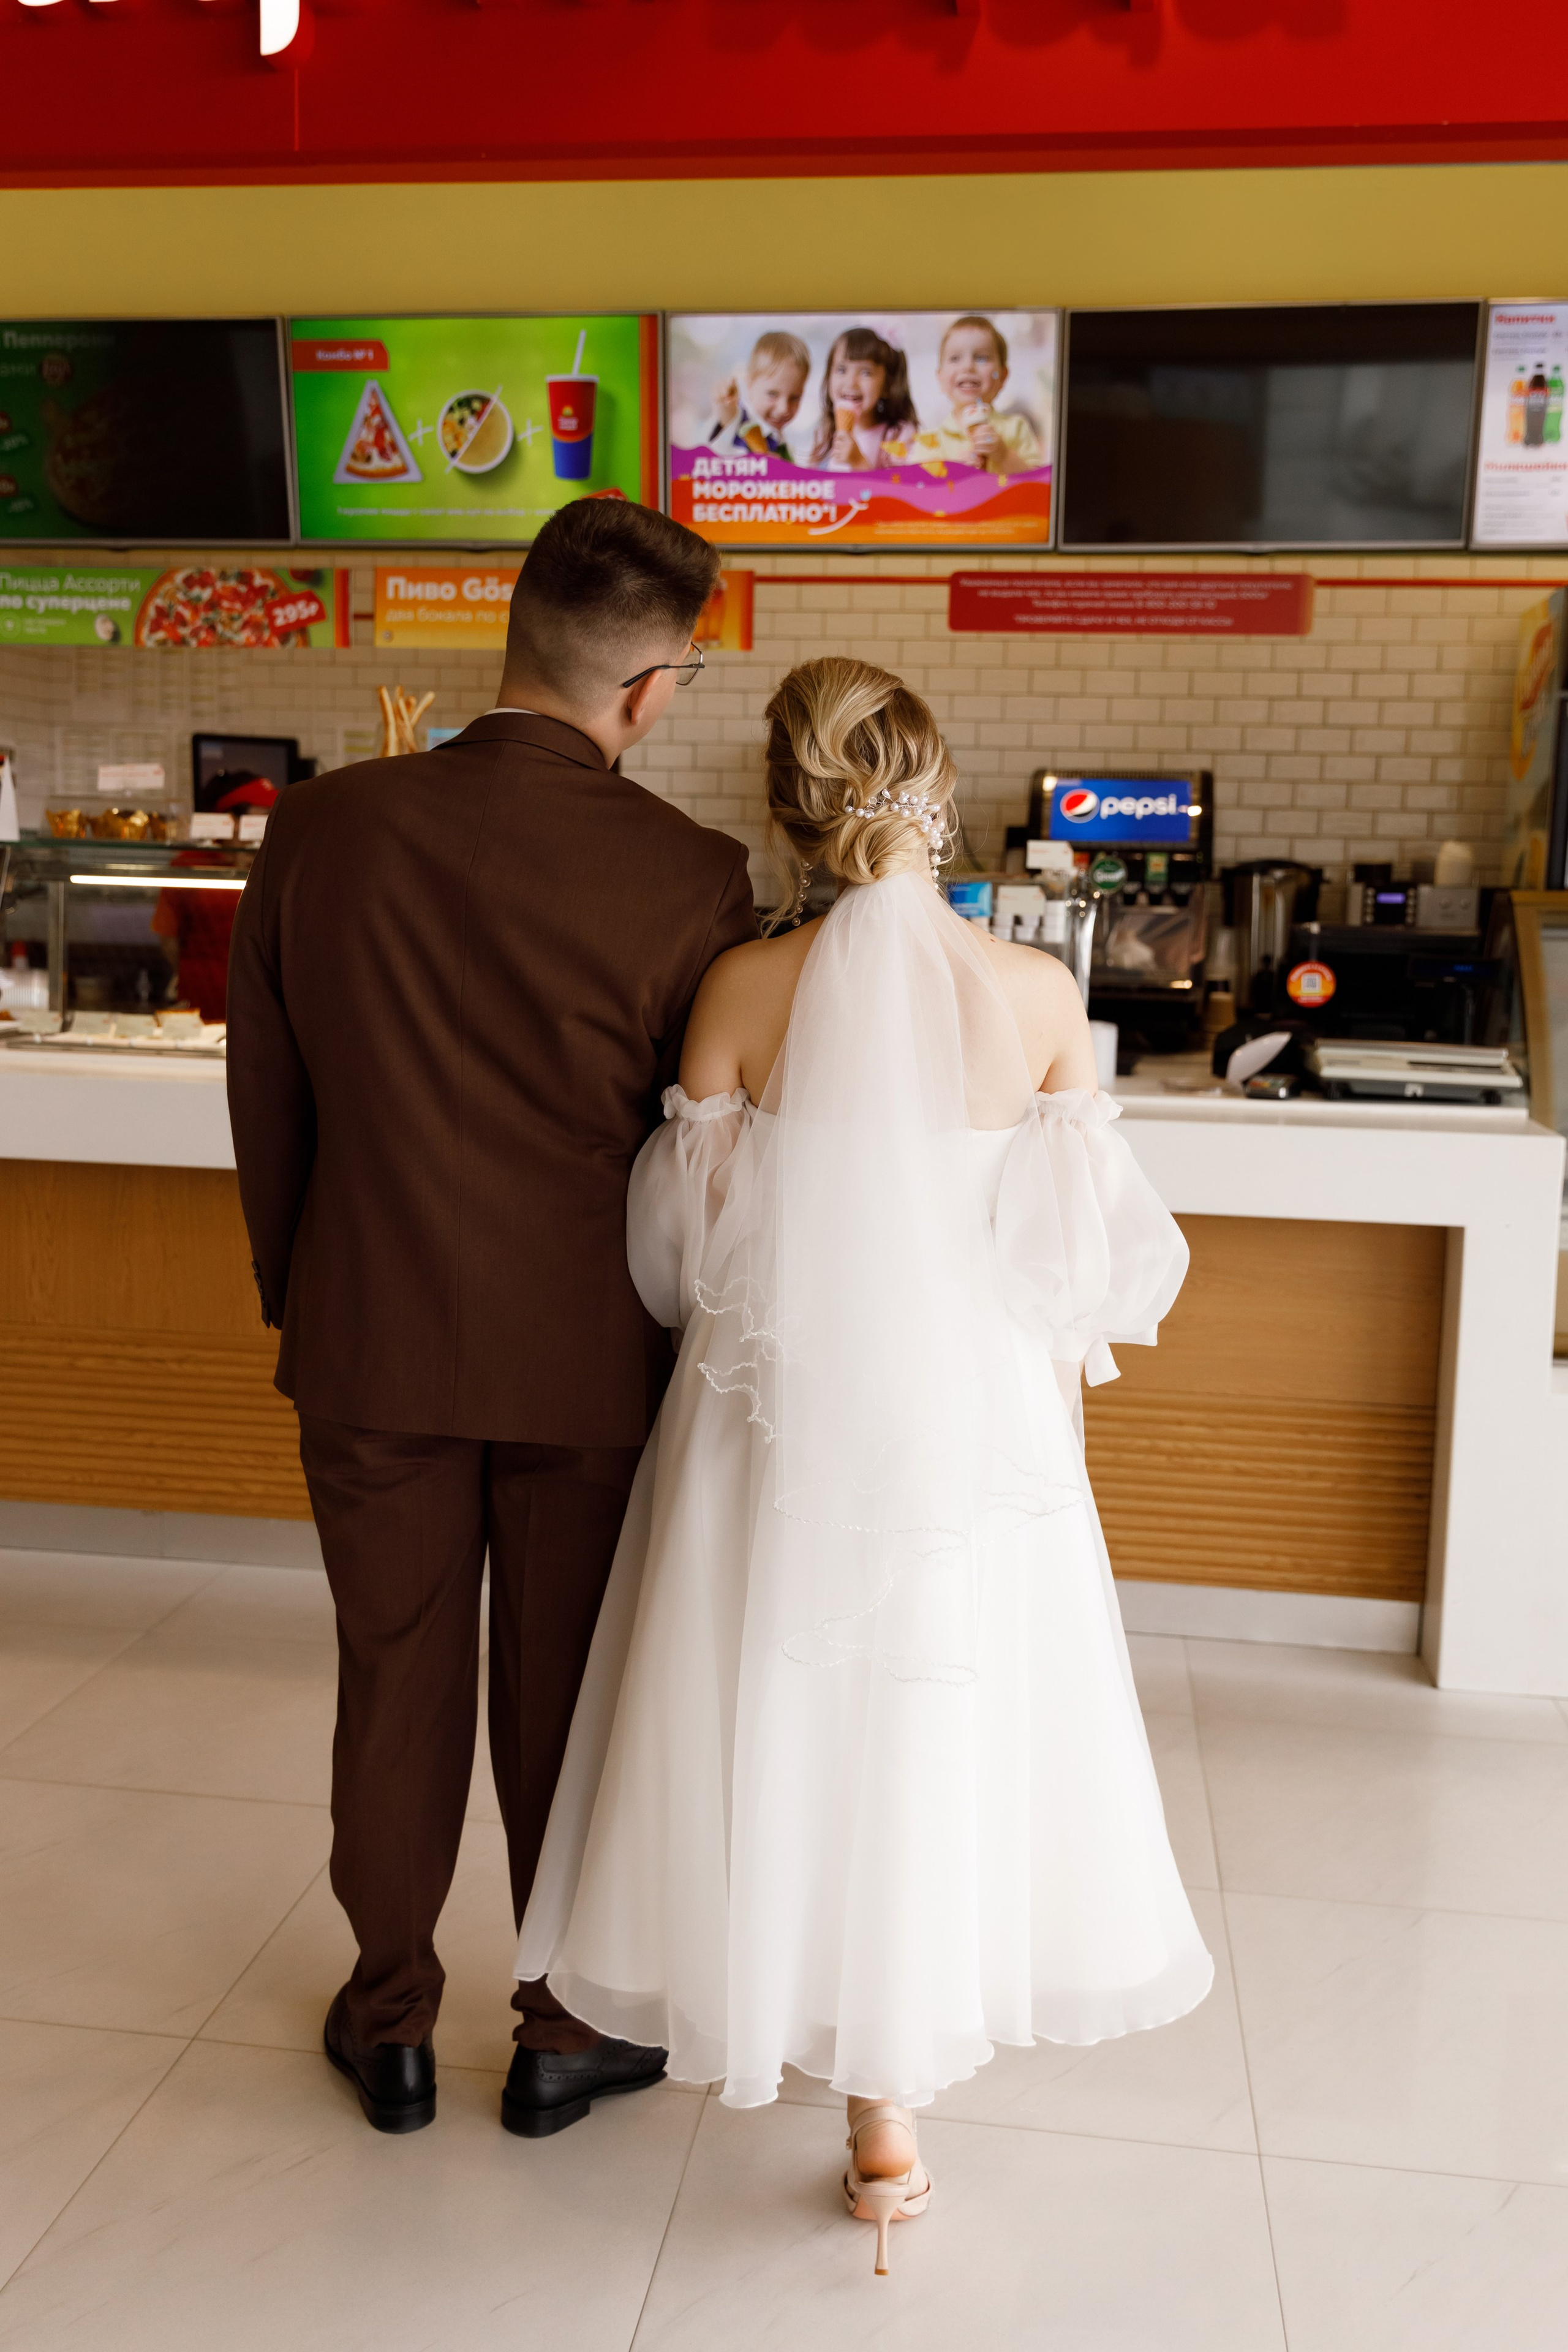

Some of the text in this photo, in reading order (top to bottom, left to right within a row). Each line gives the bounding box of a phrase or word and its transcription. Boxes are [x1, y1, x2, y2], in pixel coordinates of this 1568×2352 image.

[692, 456, 768, 480] ДЕТЯМ
[692, 480, 836, 500] МОРОЖЕНОЕ
[0, 572, 141, 597] Пицца Ассорти
[386, 575, 516, 601] Пиво Gös
[0, 595, 132, 614] по суперцене
[385, 609, 415, 622] два
[417, 605, 473, 623] бокала
[475, 610, 497, 624] по
[1100, 794, 1177, 820] pepsi
